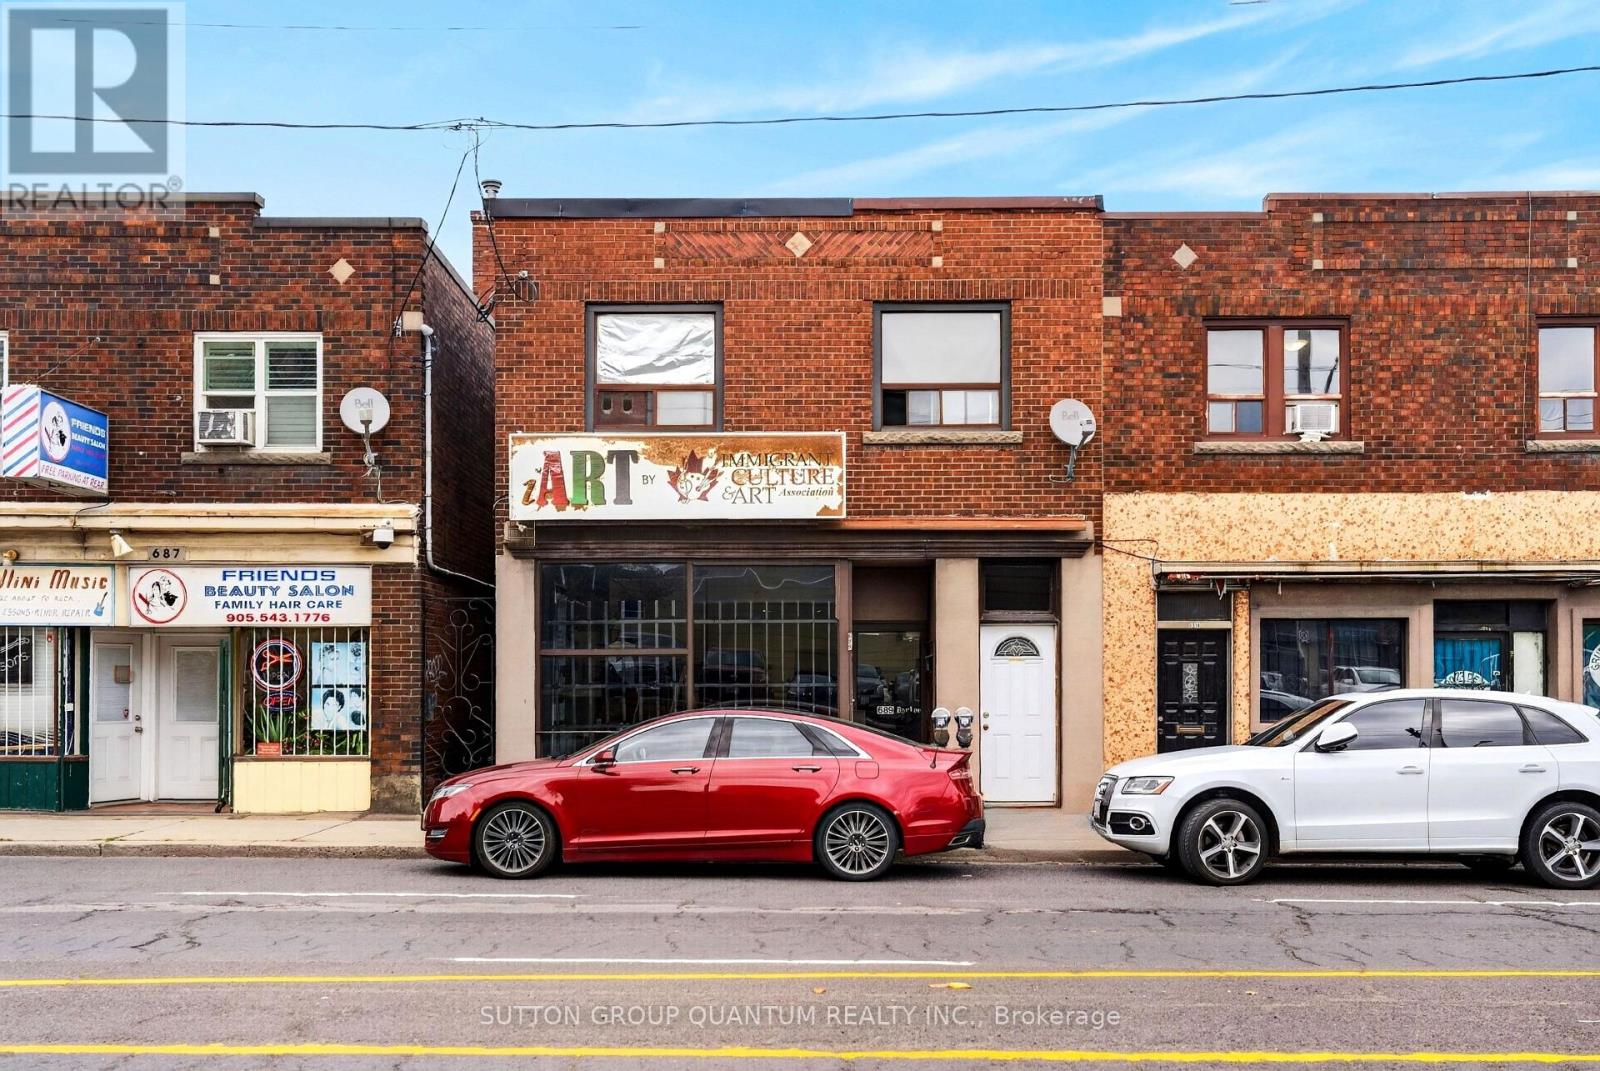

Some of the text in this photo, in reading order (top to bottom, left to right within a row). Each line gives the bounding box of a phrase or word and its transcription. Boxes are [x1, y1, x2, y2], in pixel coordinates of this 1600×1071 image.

[721, 452, 833, 467] IMMIGRANT
[41, 464, 56, 476] FREE
[642, 474, 655, 485] BY
[731, 468, 835, 486] CULTURE
[779, 487, 834, 496] Association
[152, 548, 180, 559] 687
[222, 570, 336, 582] FRIENDS
[204, 585, 354, 597] BEAUTY SALON
[214, 600, 343, 609] FAMILY HAIR CARE
[226, 613, 331, 622] 905.543.1776
[263, 696, 298, 706] OPEN
